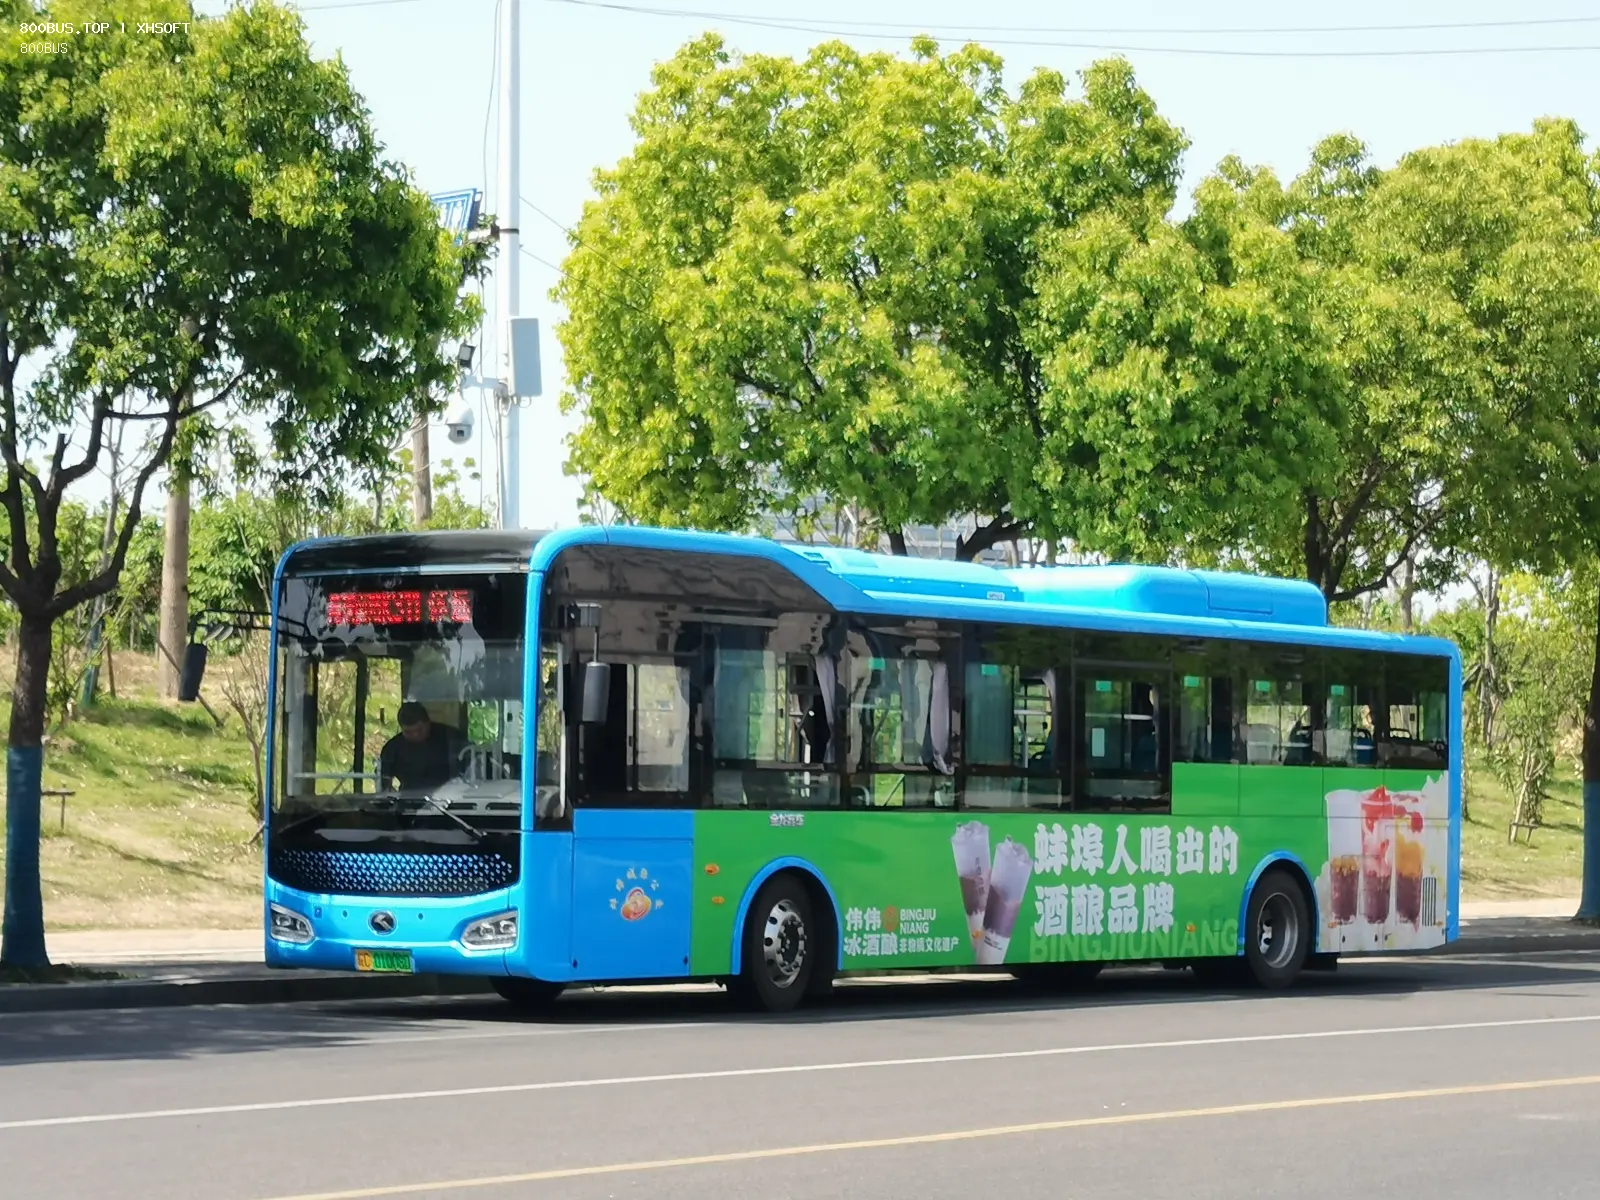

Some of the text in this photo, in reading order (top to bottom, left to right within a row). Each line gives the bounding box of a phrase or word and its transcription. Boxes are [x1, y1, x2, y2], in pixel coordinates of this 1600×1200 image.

[1033, 822, 1239, 877] 蚌埠人喝出的
[900, 908, 937, 921] BINGJIU
[1033, 881, 1174, 937] 酒酿品牌
[900, 922, 929, 934] NIANG
